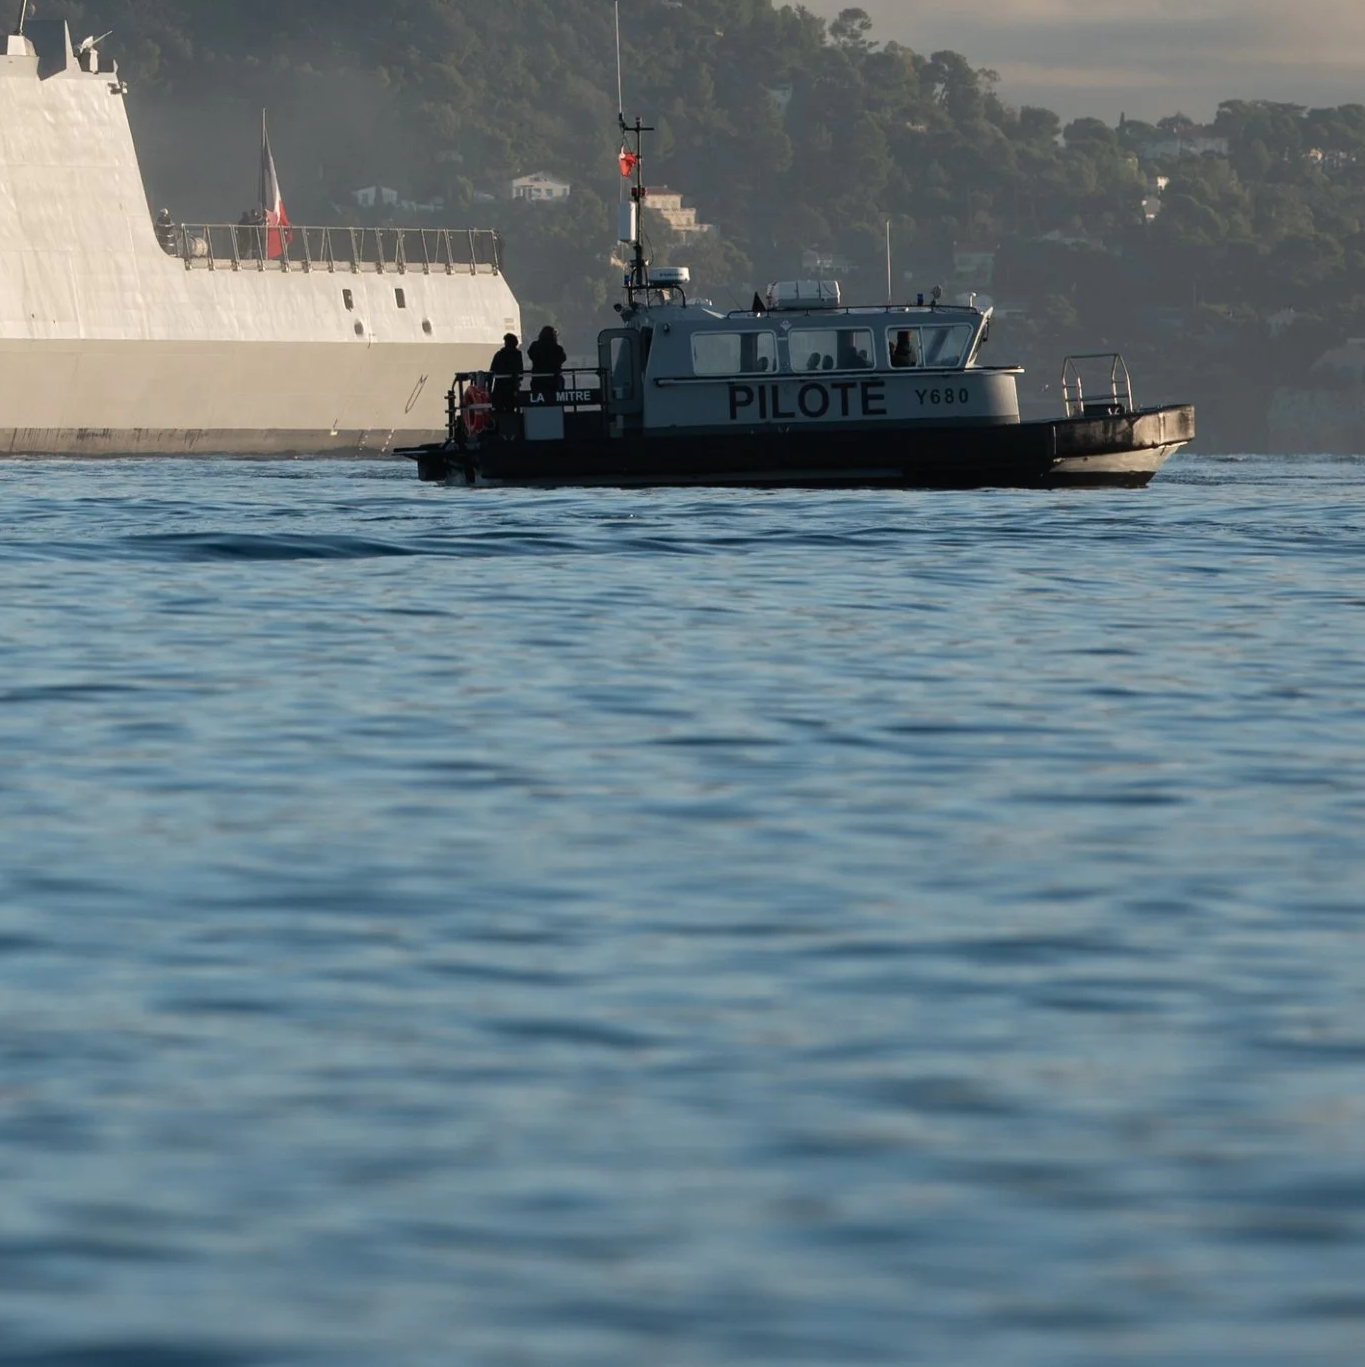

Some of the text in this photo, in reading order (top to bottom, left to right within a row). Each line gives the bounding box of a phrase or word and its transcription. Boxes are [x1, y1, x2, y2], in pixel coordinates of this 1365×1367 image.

[529, 391, 591, 403] LA MITRE
[728, 380, 887, 421] PILOTE
[914, 388, 969, 405] Y680
